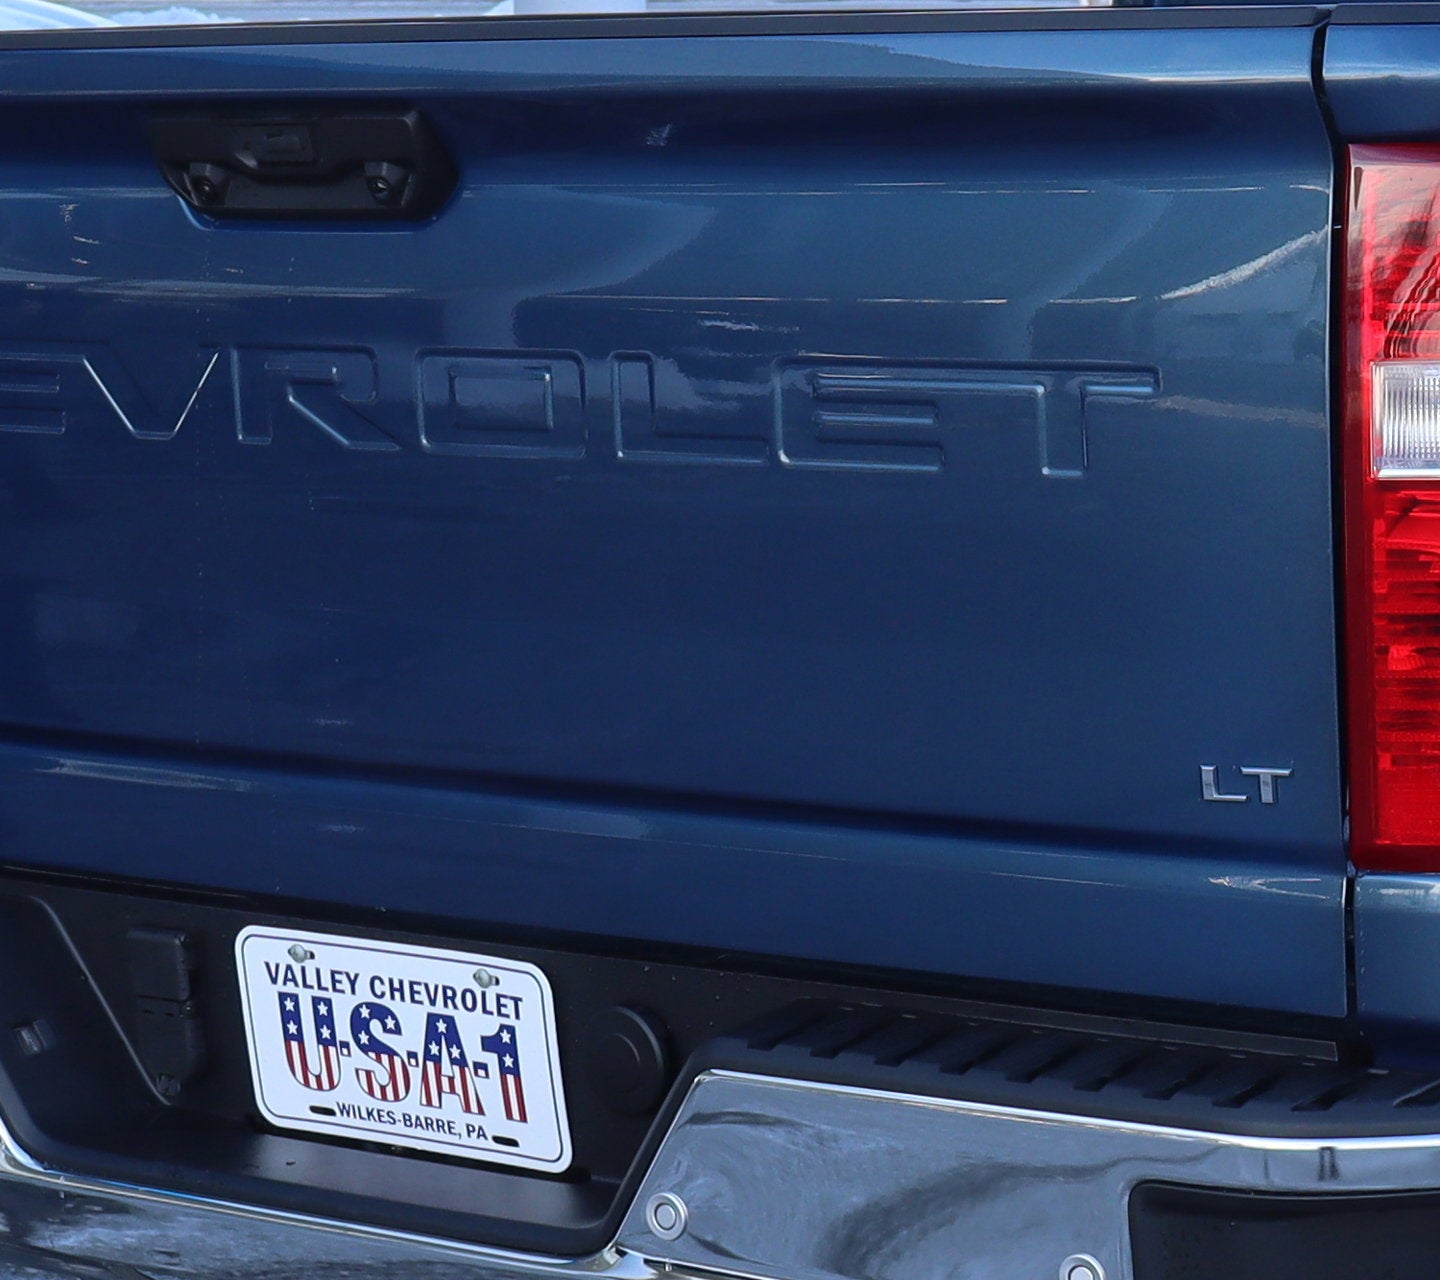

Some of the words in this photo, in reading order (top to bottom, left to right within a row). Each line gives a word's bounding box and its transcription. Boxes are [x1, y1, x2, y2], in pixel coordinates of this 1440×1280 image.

[1200, 765, 1294, 803] LT
[263, 960, 360, 996] VALLEY
[369, 974, 523, 1021] CHEVROLET
[336, 1101, 462, 1140] WILKES-BARRE,
[465, 1124, 489, 1142] PA
